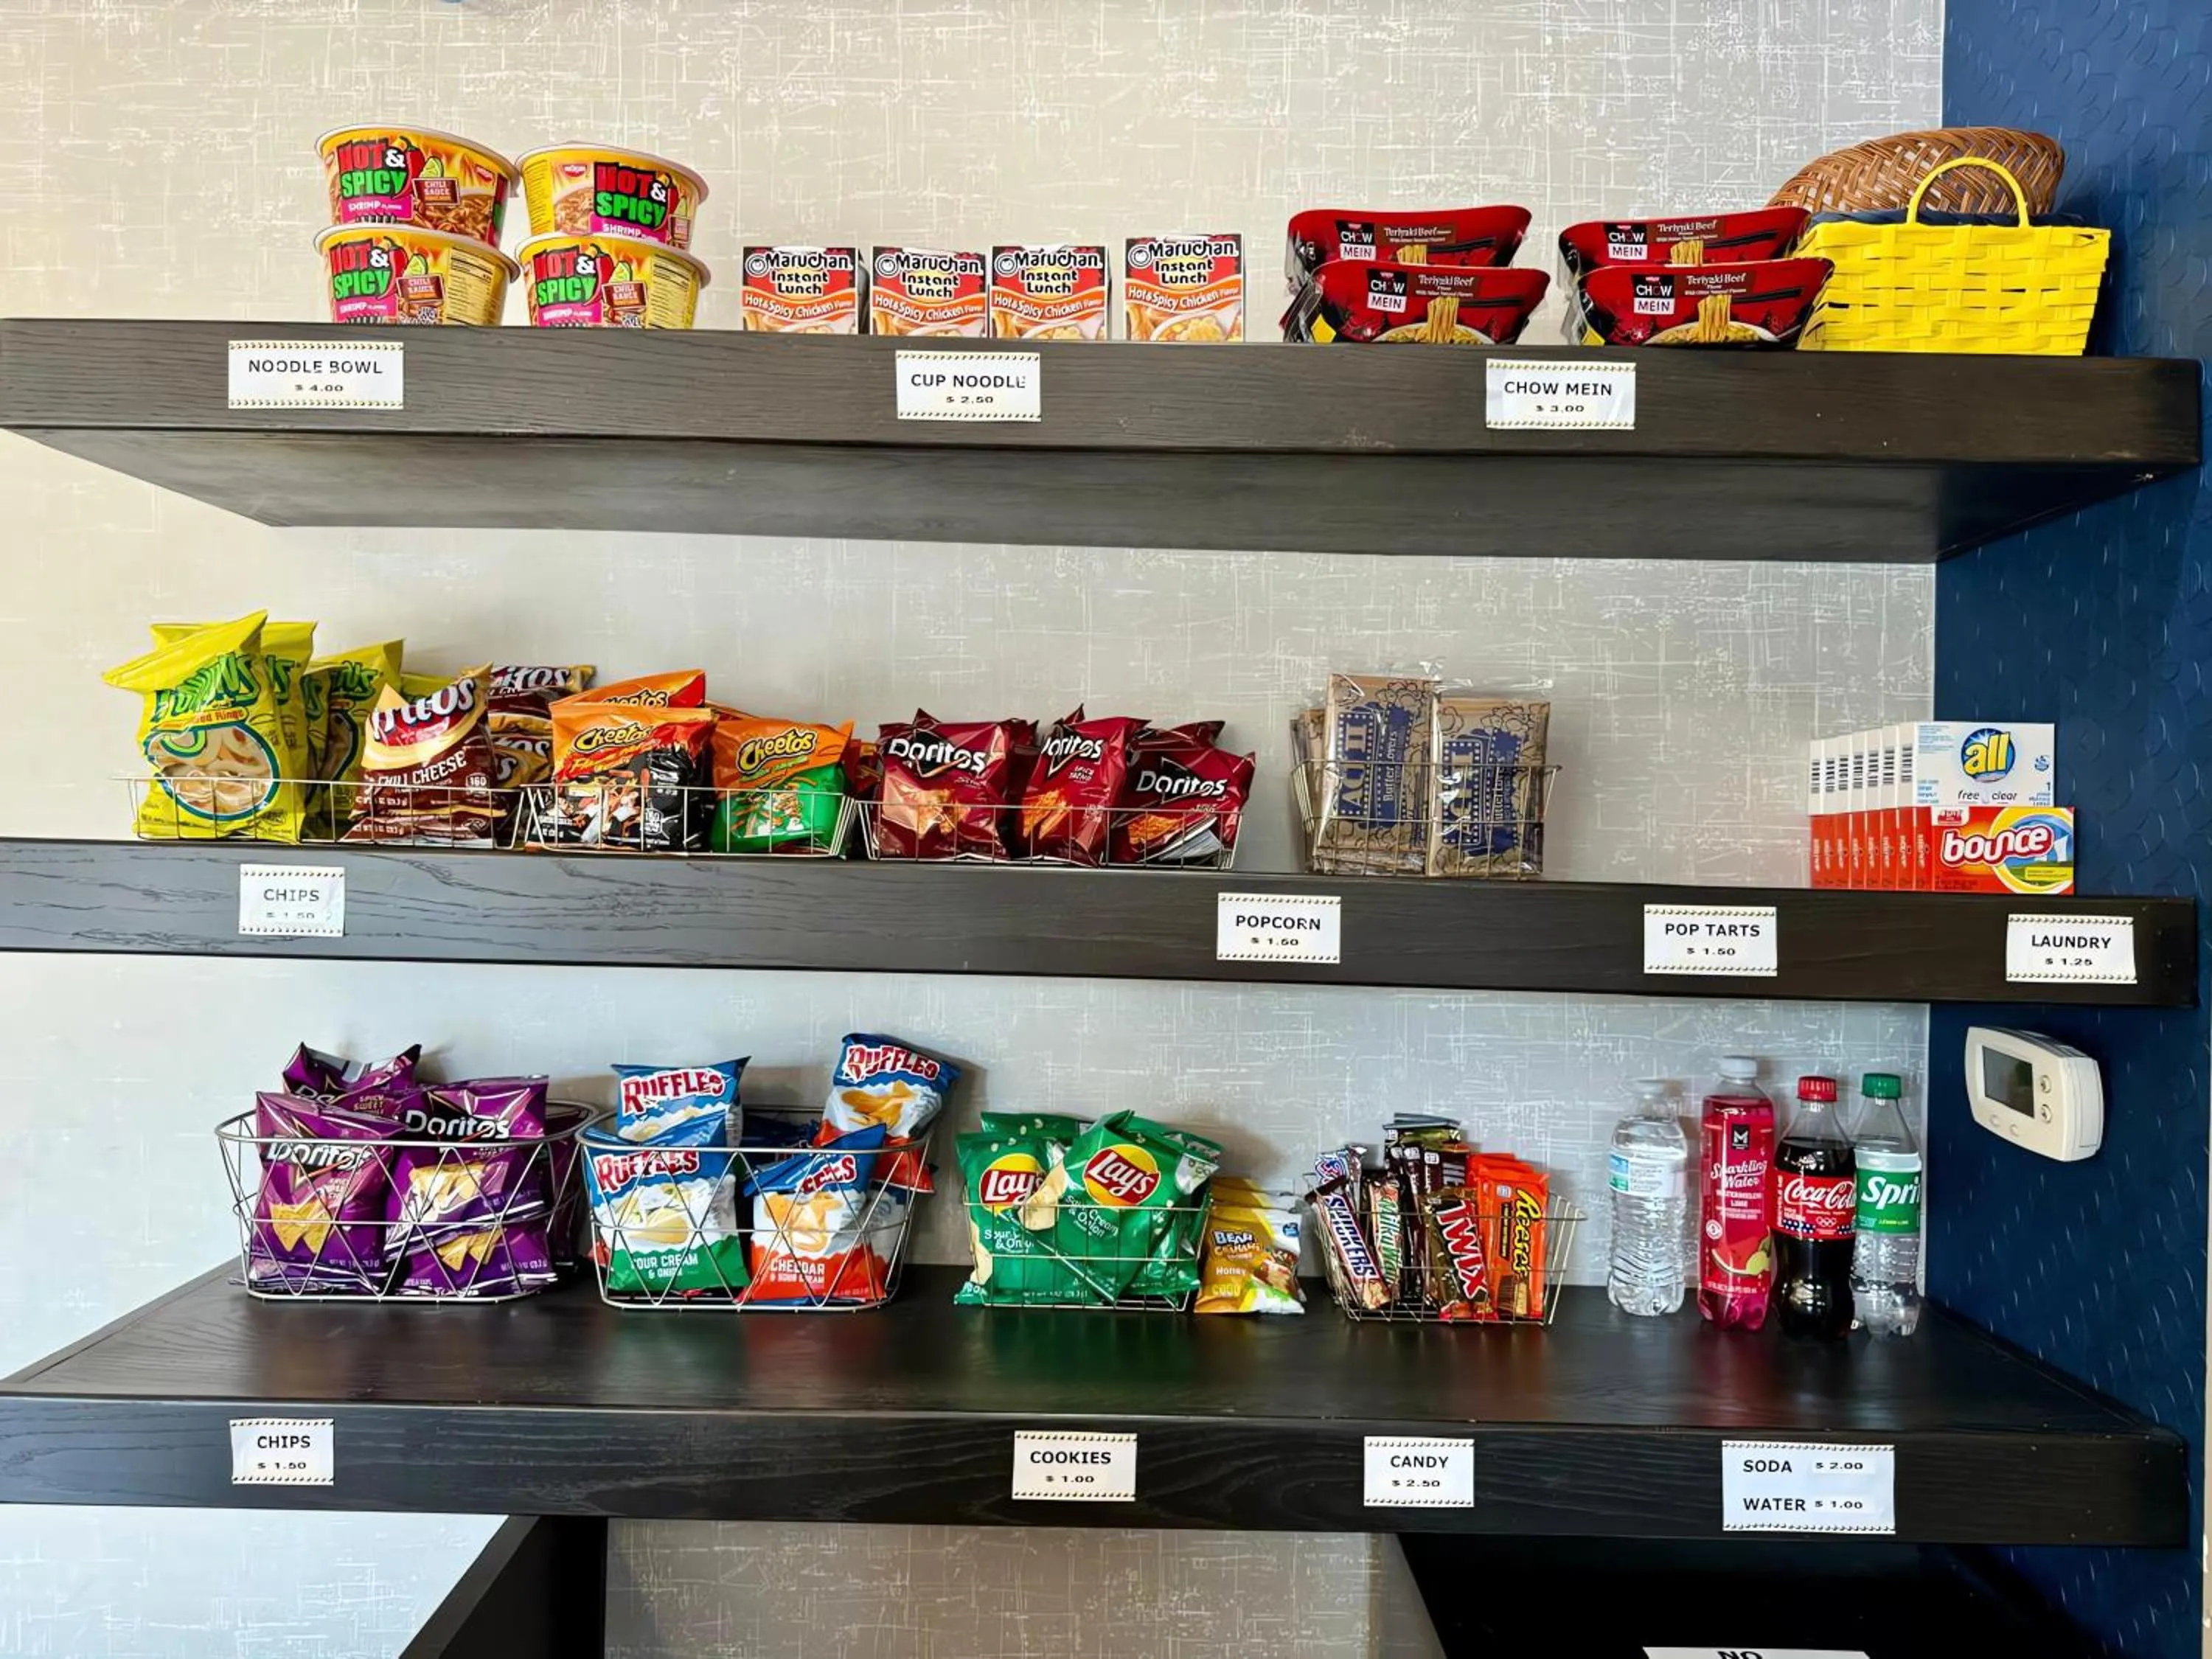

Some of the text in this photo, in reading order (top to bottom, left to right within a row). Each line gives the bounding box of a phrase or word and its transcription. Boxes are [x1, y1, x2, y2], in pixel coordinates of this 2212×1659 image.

[341, 170, 405, 198] SPICY
[597, 192, 666, 227] SPICY
[602, 223, 641, 238] SHRIMP
[1418, 226, 1437, 236] Beef
[1695, 219, 1717, 230] Beef
[1341, 231, 1373, 243] CHOW
[1609, 232, 1645, 243] CHOW
[1149, 241, 1235, 257] Maruchan
[1343, 246, 1372, 258] MEIN
[1613, 246, 1643, 257] MEIN
[767, 252, 848, 269] Maruchan
[896, 254, 979, 274] Maruchan
[1015, 251, 1099, 268] Maruchan
[1155, 259, 1213, 272] Instant
[772, 271, 828, 283] Instant
[902, 273, 959, 286] Instant
[1020, 269, 1078, 282] Instant
[1161, 271, 1207, 285] Lunch
[1453, 276, 1474, 286] Beef
[1724, 272, 1747, 283] Beef
[334, 271, 391, 299] SPICY
[538, 276, 597, 306] SPICY
[778, 282, 822, 294] Lunch
[908, 285, 953, 298] Lunch
[1026, 281, 1071, 293] Lunch
[1371, 279, 1405, 293] CHOW
[1636, 285, 1672, 296] CHOW
[1180, 292, 1218, 307] Chicken
[1371, 296, 1402, 310] MEIN
[1637, 301, 1670, 312] MEIN
[796, 303, 833, 318] Chicken
[925, 306, 964, 321] Chicken
[1045, 302, 1083, 317] Chicken
[248, 360, 383, 374] NOODLE BOWL
[911, 374, 1026, 388] CUP NOODLE
[1504, 381, 1612, 396] CHOW MEIN
[961, 396, 994, 404] 2.50
[1550, 405, 1585, 413] 3.00
[739, 728, 815, 772] Cheetos
[888, 738, 987, 773] Doritos
[1964, 731, 2010, 775] all
[412, 750, 467, 785] CHEESE
[1136, 771, 1228, 796] Doritos
[1958, 790, 2017, 801] free clear
[1944, 827, 2048, 863] bounce
[263, 888, 319, 902] CHIPS
[1235, 915, 1321, 931] POPCORN
[1665, 923, 1760, 937] POP TARTS
[1267, 938, 1298, 946] 1.50
[2031, 935, 2111, 949] LAUNDRY
[1703, 947, 1735, 956] 1.50
[2061, 958, 2093, 966] 1.25
[847, 1046, 939, 1081] RUFFLES
[624, 1071, 726, 1114] RUFFLES
[406, 1110, 509, 1141] Doritos
[1089, 1151, 1152, 1196] Lay's
[1327, 1196, 1377, 1276] SNICKERS
[1439, 1200, 1487, 1299] TWIX
[1216, 1267, 1246, 1276] Honey
[257, 1436, 310, 1448] CHIPS
[1030, 1451, 1111, 1464] COOKIES
[1390, 1455, 1448, 1468] CANDY
[1743, 1460, 1792, 1472] SODA
[1744, 1498, 1806, 1512] WATER
[1832, 1501, 1863, 1509] 1.00
